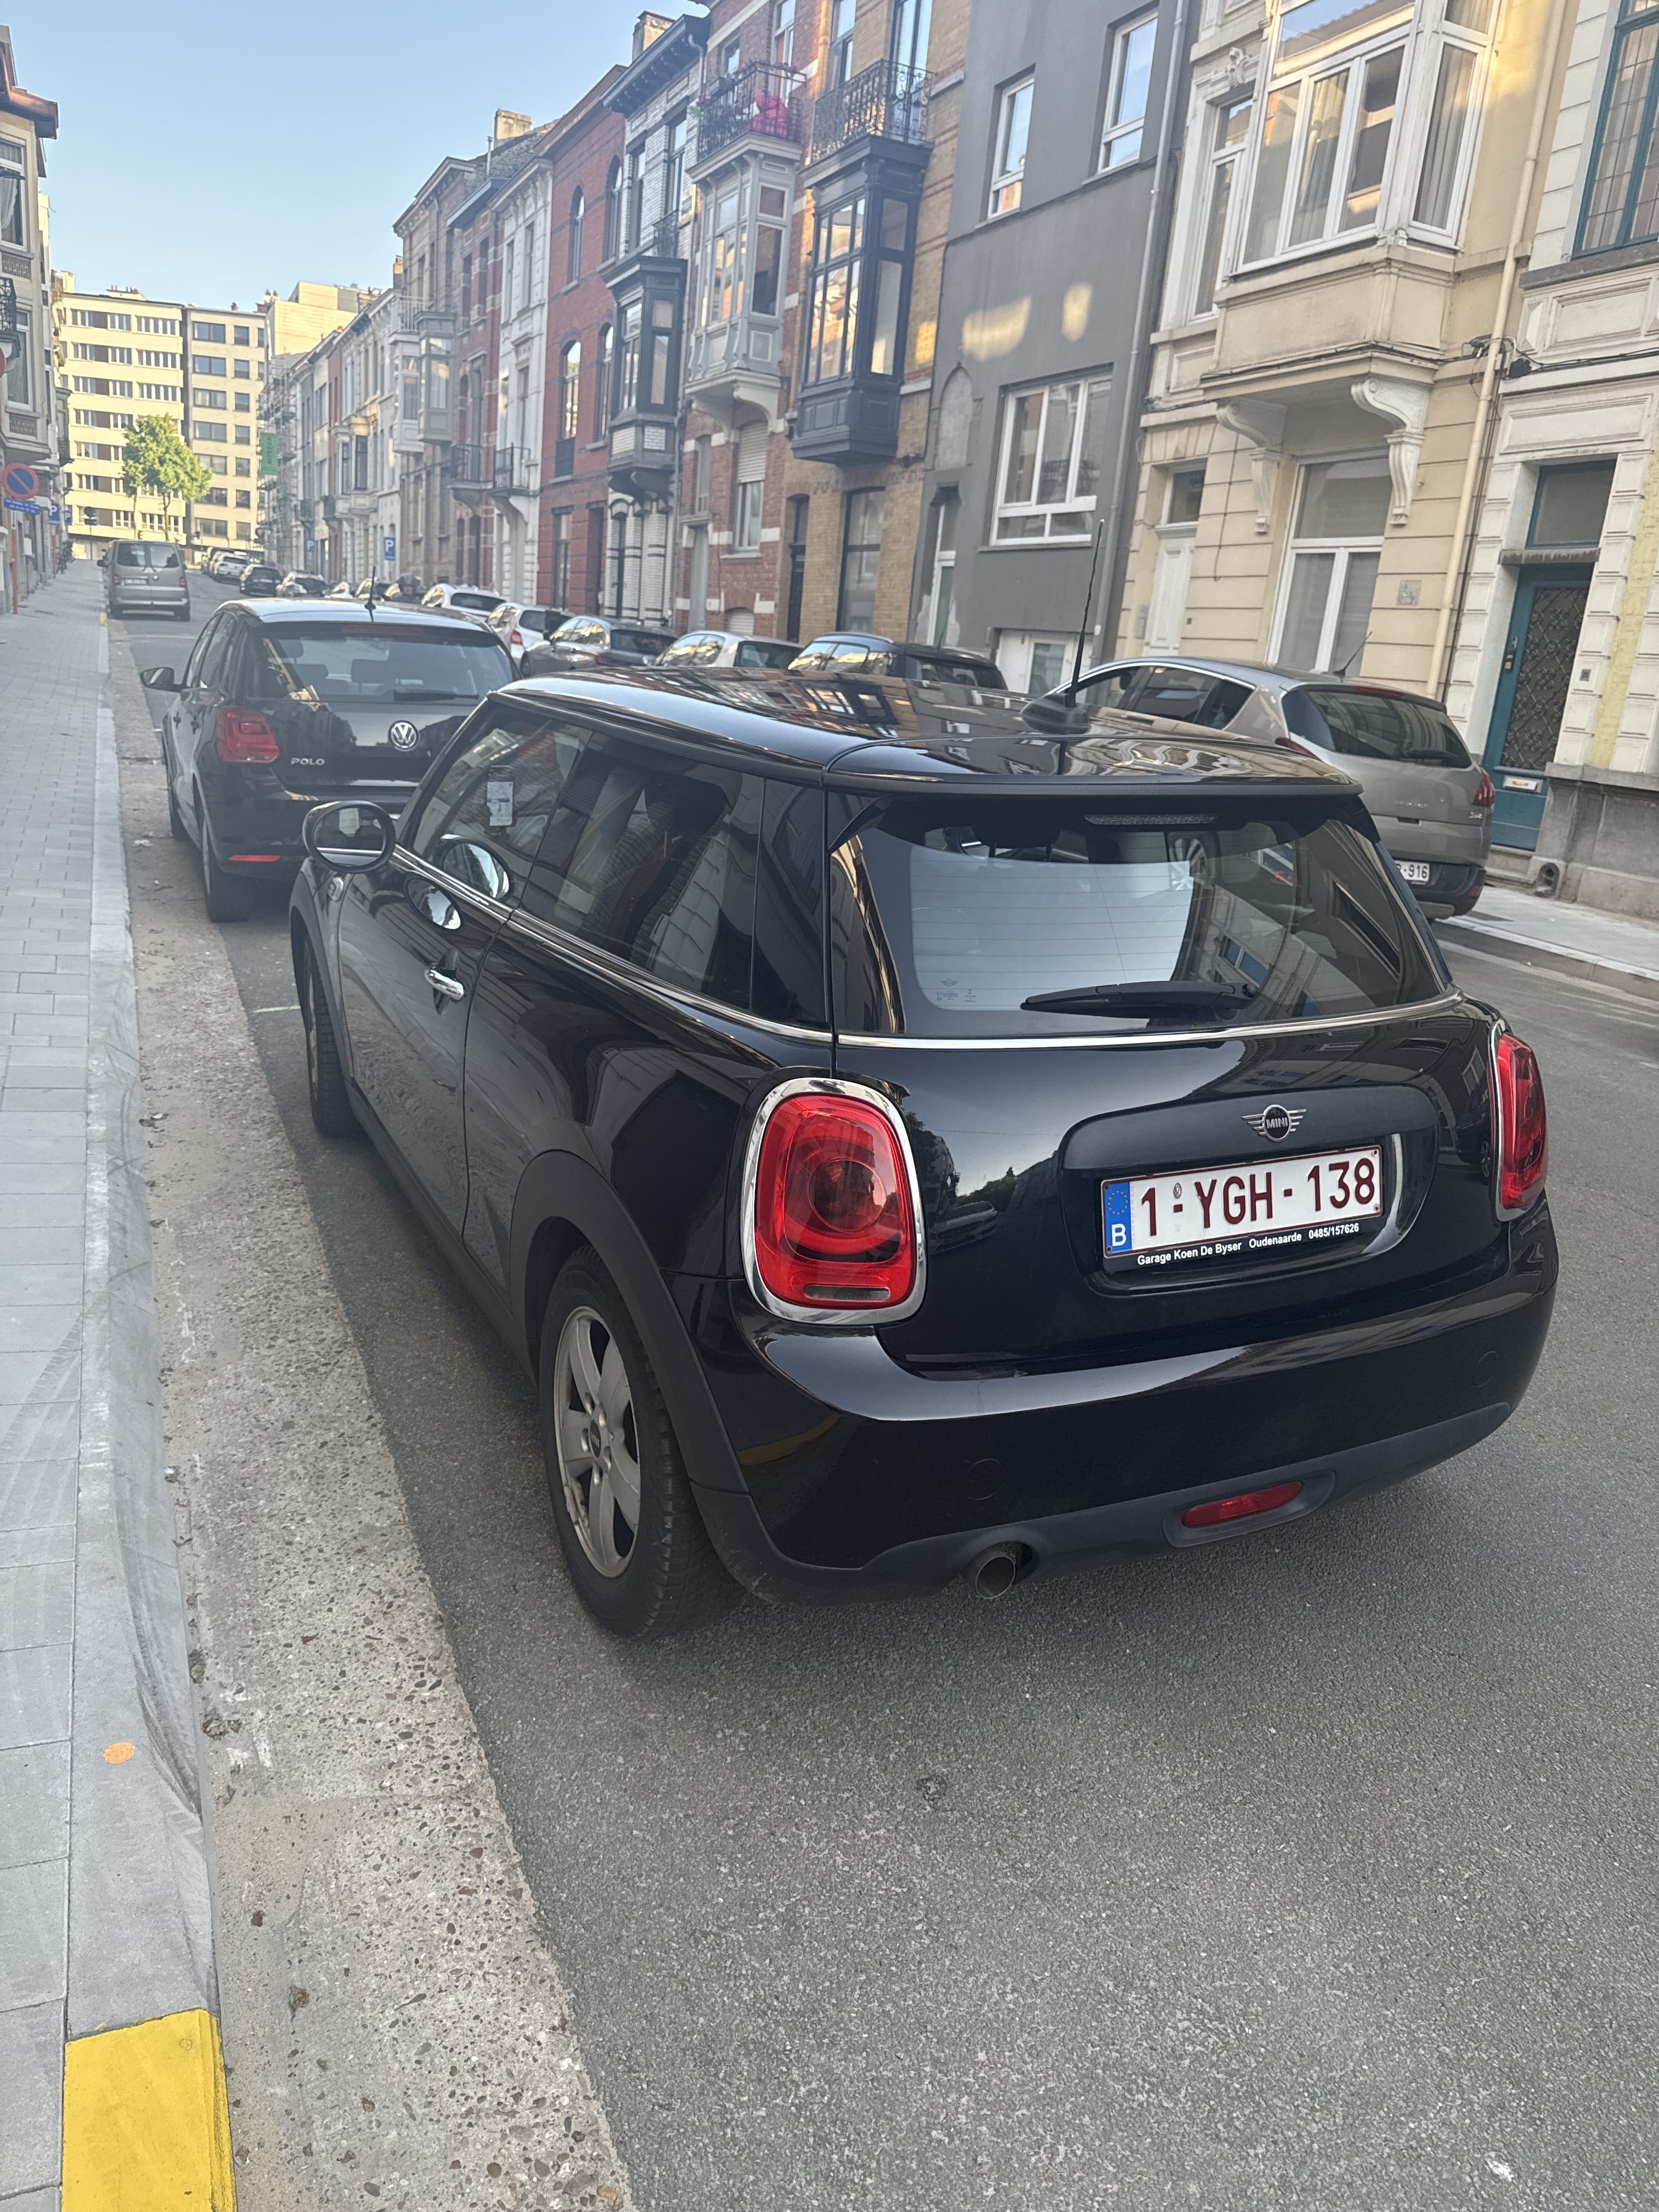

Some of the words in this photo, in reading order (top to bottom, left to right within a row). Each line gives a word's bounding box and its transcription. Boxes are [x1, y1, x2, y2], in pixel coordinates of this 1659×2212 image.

[49, 505, 58, 516] P
[65, 512, 71, 521] P
[307, 540, 314, 550] P
[291, 758, 325, 766] POLO
[1266, 1117, 1288, 1129] MINI
[1111, 1223, 1127, 1247] B
[1137, 1254, 1171, 1266] Garage
[1173, 1249, 1198, 1260] Koen
[1200, 1246, 1213, 1256] De
[1215, 1242, 1242, 1255] Byser
[1249, 1232, 1302, 1248] Oudenaarde
[1308, 1222, 1359, 1240] 0485/157626
